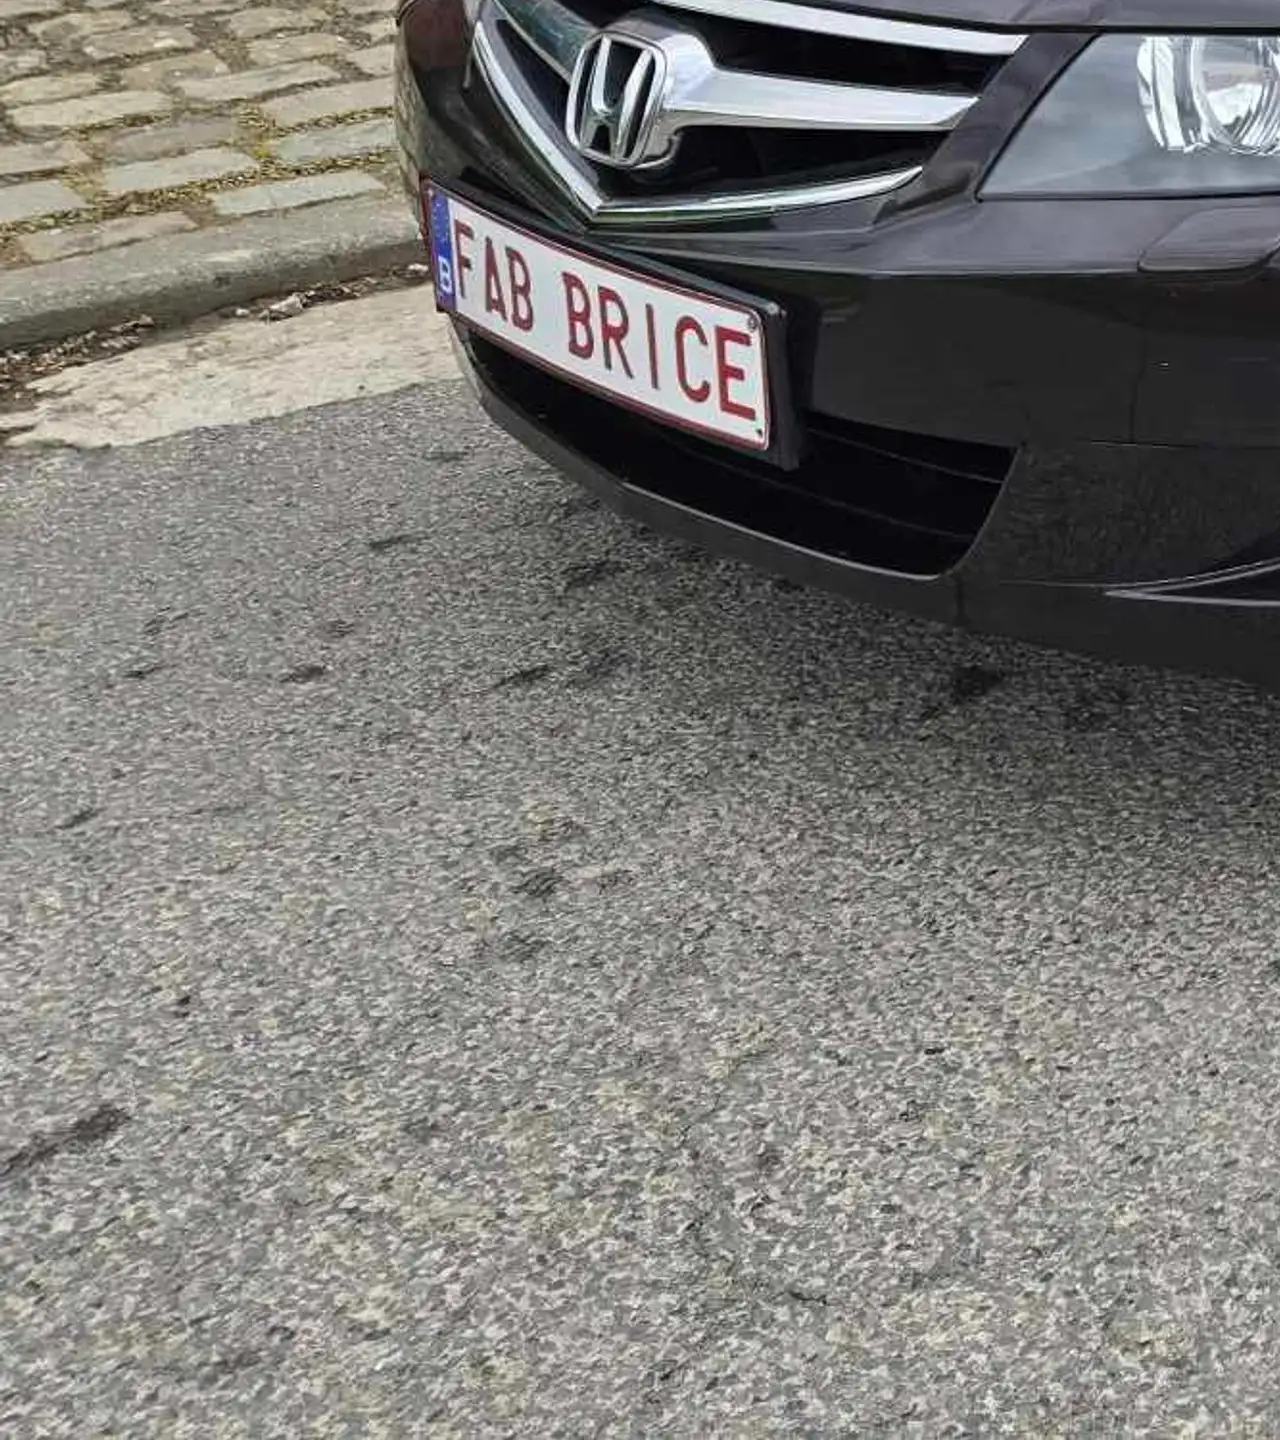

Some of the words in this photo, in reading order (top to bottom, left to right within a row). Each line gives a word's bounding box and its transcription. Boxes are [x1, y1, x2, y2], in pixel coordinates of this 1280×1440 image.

[438, 255, 453, 294] B
[453, 218, 535, 332] FAB
[561, 270, 757, 421] BRICE
